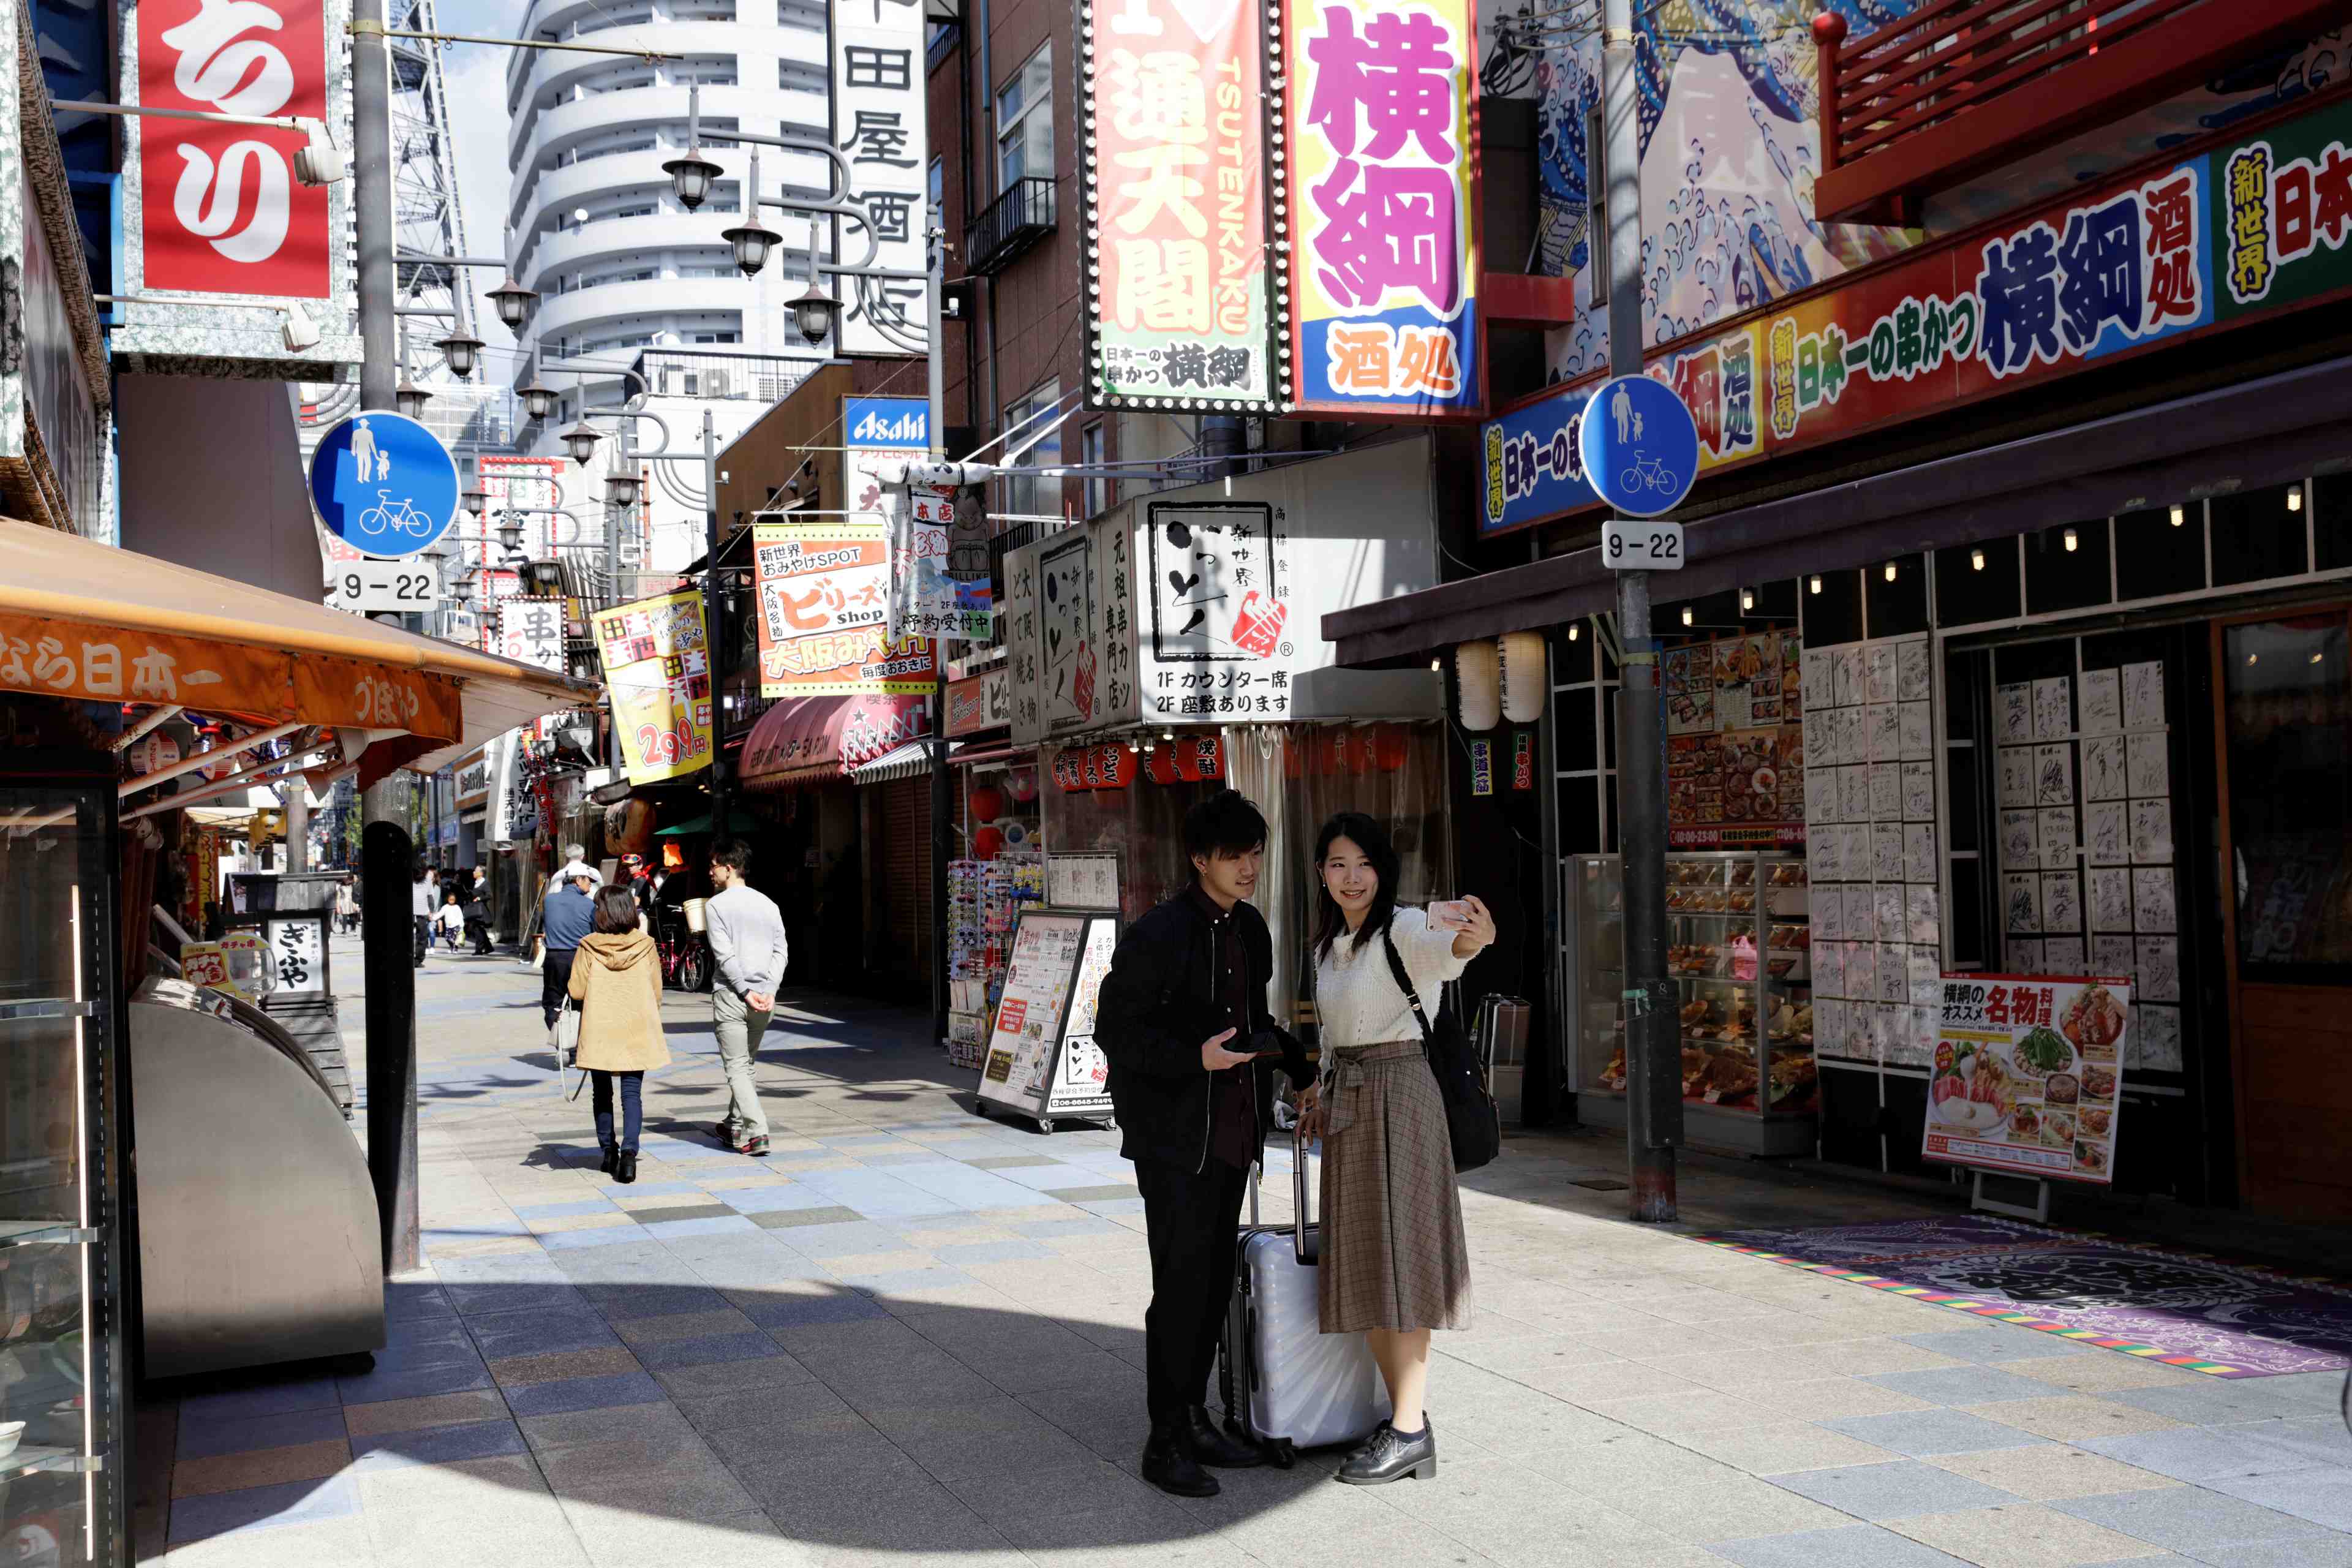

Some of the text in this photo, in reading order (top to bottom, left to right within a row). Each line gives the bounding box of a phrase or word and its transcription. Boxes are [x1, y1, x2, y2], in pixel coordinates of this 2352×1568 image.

[1308, 5, 1458, 315] 横綱
[1110, 48, 1213, 334] 通天閣
[1215, 57, 1251, 336] TSUTENKAKU
[2233, 146, 2270, 298] 新世界
[2144, 176, 2196, 327] 酒処
[1979, 195, 2143, 371] 横綱
[1106, 347, 1161, 362] 日本一の
[1107, 367, 1160, 385] 串かつ
[1163, 342, 1251, 391] 横綱
[1333, 328, 1455, 391] 酒処
[1771, 320, 1797, 435] 新世界
[1797, 290, 1977, 408] 日本一の串かつ
[1722, 336, 1754, 450] 酒処
[854, 411, 925, 442] Asahi
[1485, 425, 1504, 522] 新世界
[760, 544, 800, 563] 新世界
[1230, 524, 1259, 587] 新世界
[1275, 507, 1290, 598] 商標登録
[764, 584, 783, 638] 大阪名物
[778, 577, 883, 630] ビリーズ
[1114, 530, 1129, 709] 元祖串カツ
[861, 657, 932, 679] 毎度おおきに
[1105, 604, 1119, 710] 専門店
[1157, 671, 1288, 689] 1F カウンター席
[1156, 695, 1289, 714] 2F 座敷あります
[1102, 747, 1119, 784] いっとく
[1197, 738, 1216, 775] 焼酎
[278, 922, 309, 989] ぎふや
[1942, 1006, 1983, 1022] オススメ
[1943, 982, 1985, 1005] 横綱の
[1984, 984, 2039, 1026] 名物
[2038, 987, 2054, 1027] 料理
